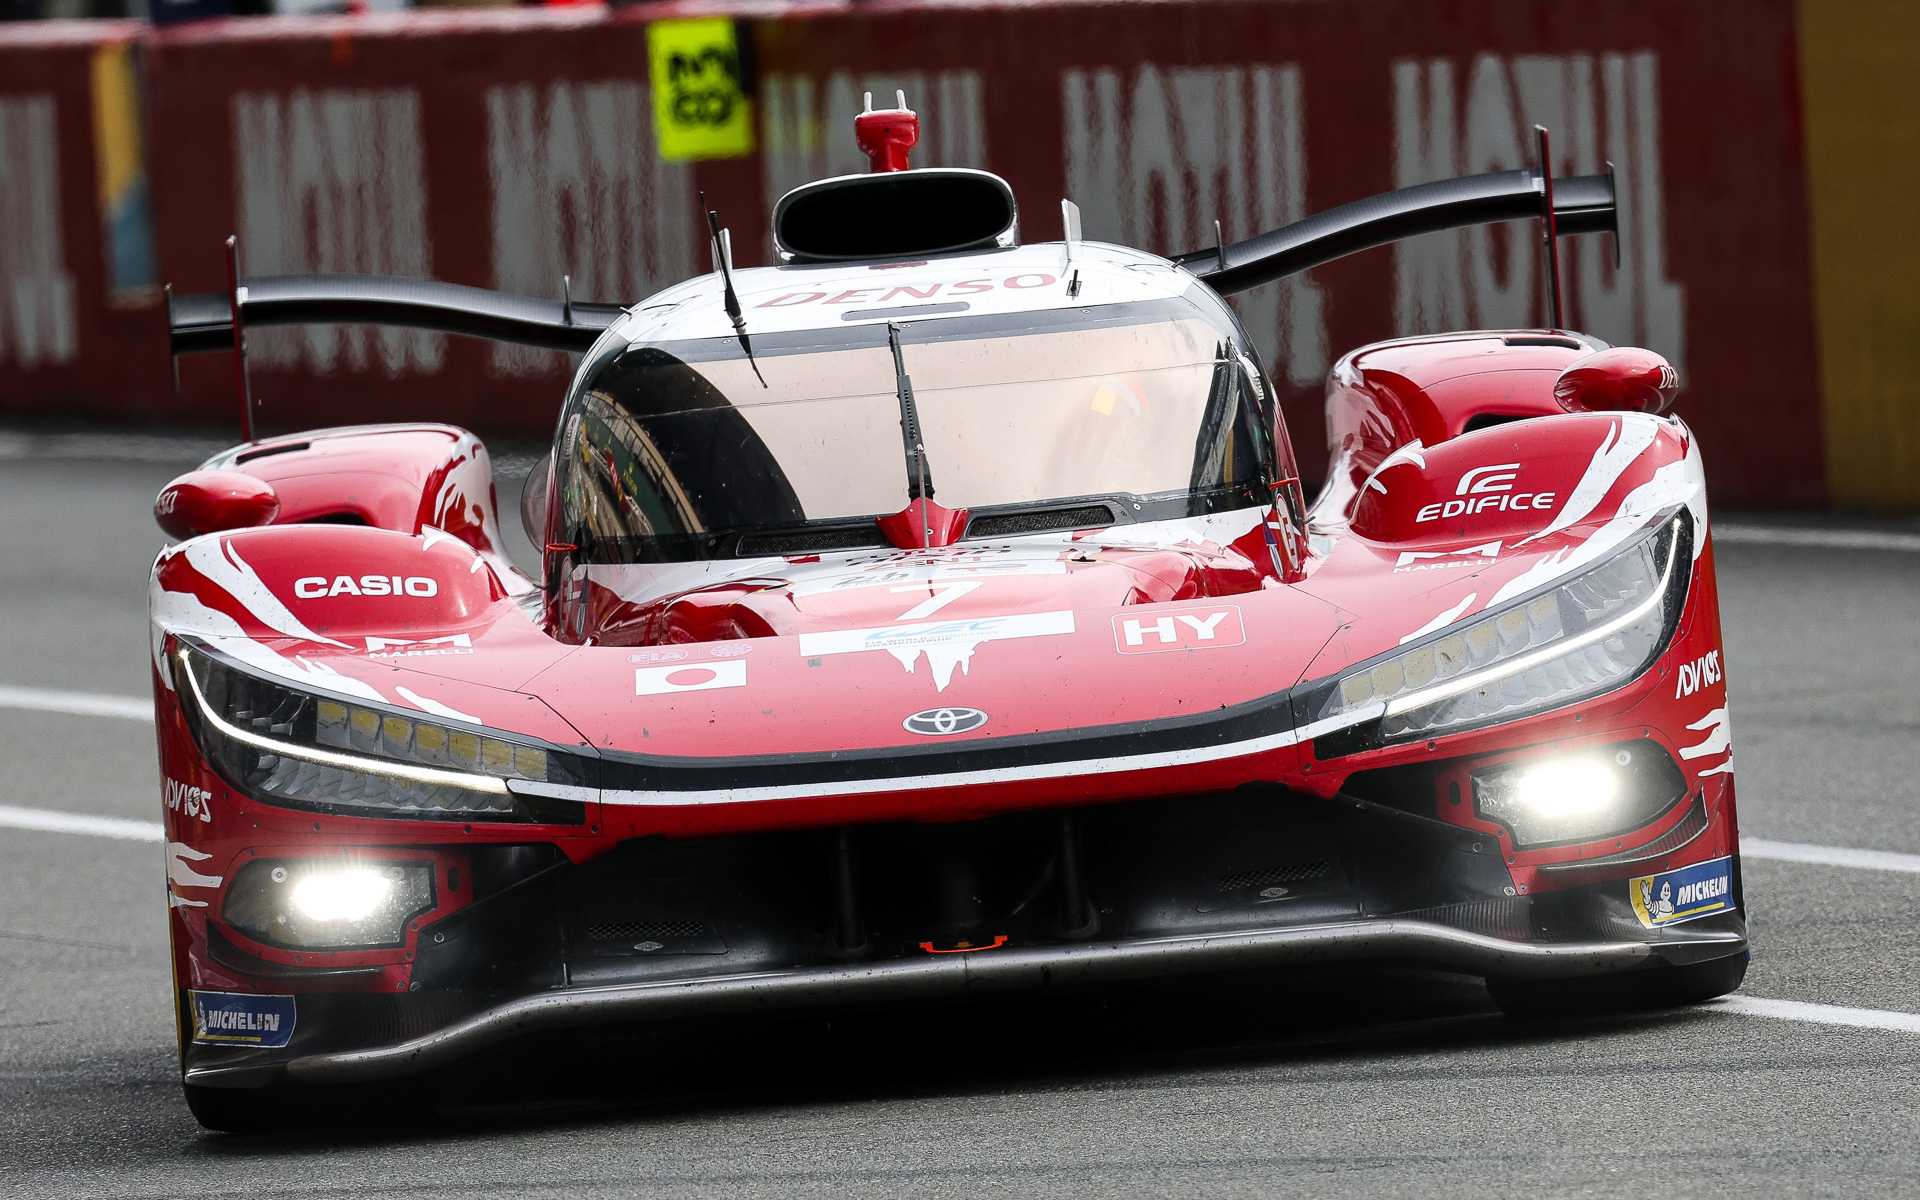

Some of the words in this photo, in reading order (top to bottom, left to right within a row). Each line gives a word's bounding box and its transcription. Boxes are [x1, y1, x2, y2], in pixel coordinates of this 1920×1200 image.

[753, 273, 1056, 309] DENSO
[1415, 492, 1556, 523] EDIFICE
[1392, 557, 1497, 574] MARELLI
[294, 574, 438, 599] CASIO
[889, 580, 984, 621] 7
[1122, 611, 1231, 646] HY
[368, 647, 474, 659] MARELLI
[1676, 875, 1729, 907] MICHELIN
[208, 1010, 280, 1032] MICHELIN
